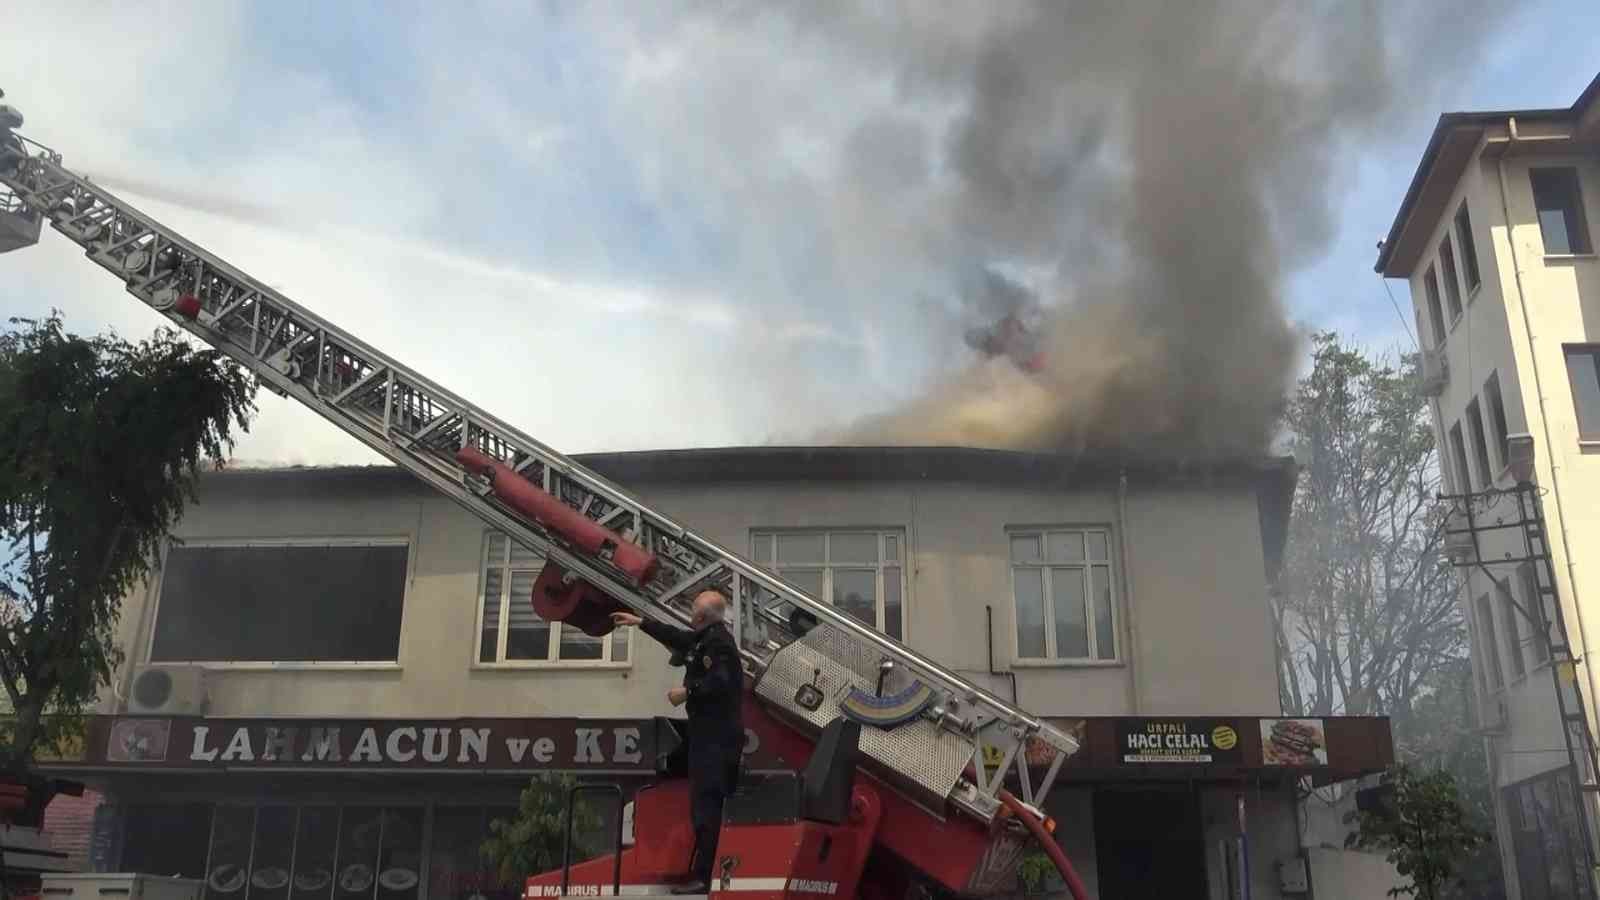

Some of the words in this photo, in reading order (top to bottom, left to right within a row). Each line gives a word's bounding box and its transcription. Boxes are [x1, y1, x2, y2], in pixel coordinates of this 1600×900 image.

[190, 726, 492, 764] LAHMACUN
[505, 736, 556, 763] ve
[1165, 733, 1209, 749] CELAL
[543, 885, 599, 897] MAIRUS
